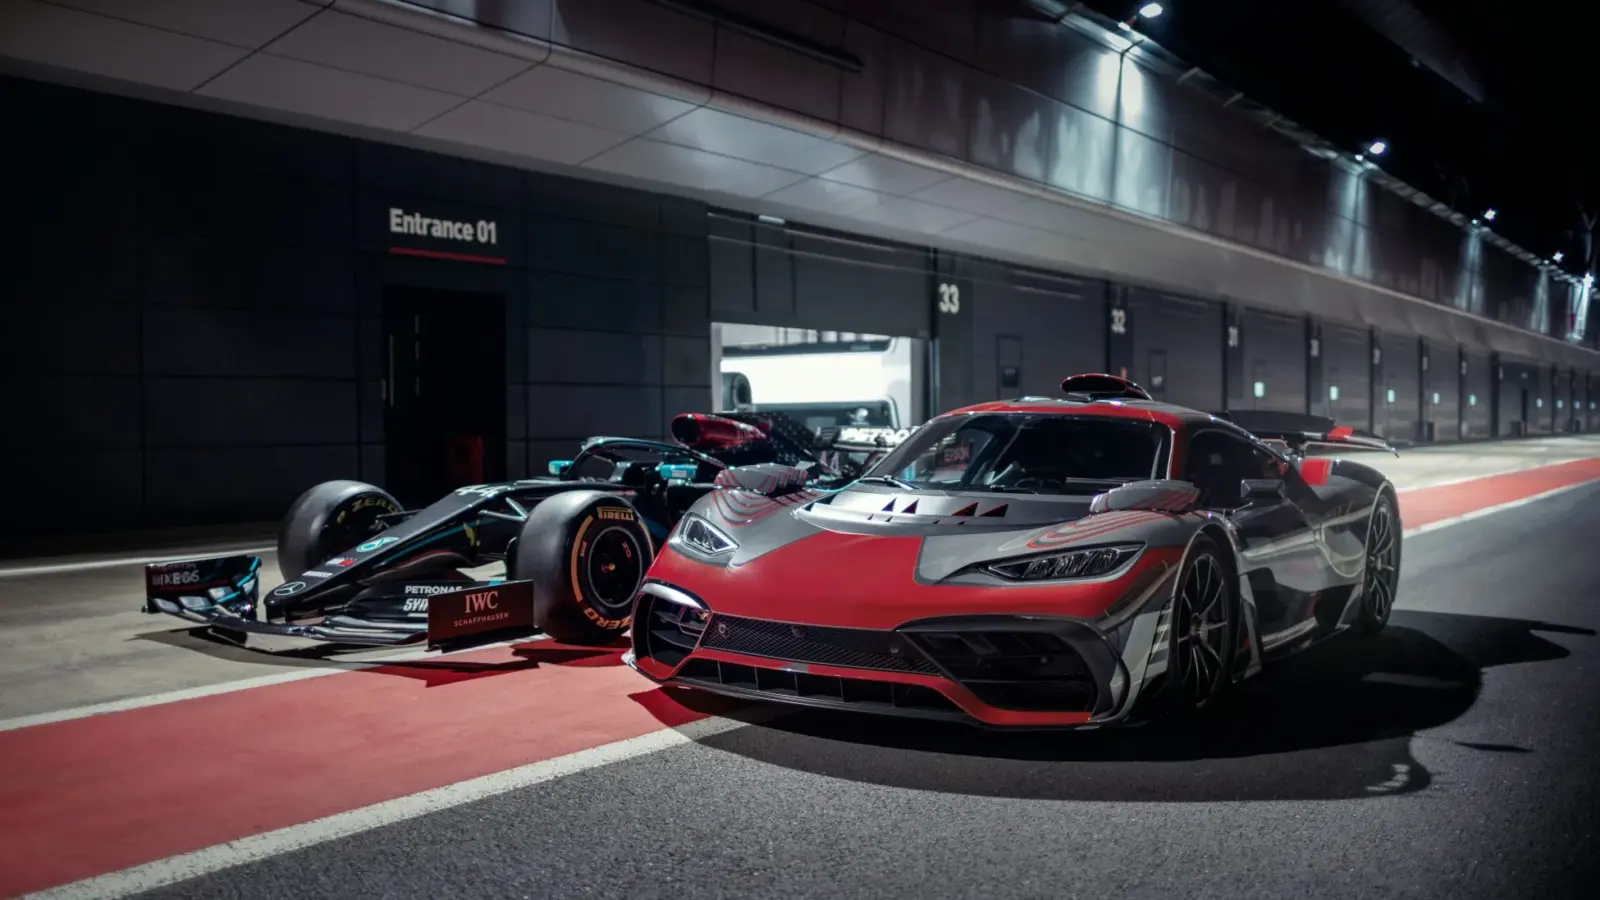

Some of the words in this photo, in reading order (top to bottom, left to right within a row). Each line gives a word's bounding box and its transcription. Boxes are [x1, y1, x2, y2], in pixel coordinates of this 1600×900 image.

[390, 207, 475, 242] Entrance
[477, 219, 497, 245] 01
[939, 283, 960, 314] 33
[351, 497, 398, 514] ZERO
[404, 585, 463, 595] PETRONAS
[465, 591, 499, 614] IWC
[453, 612, 509, 627] SCHAFFHAUSEN
